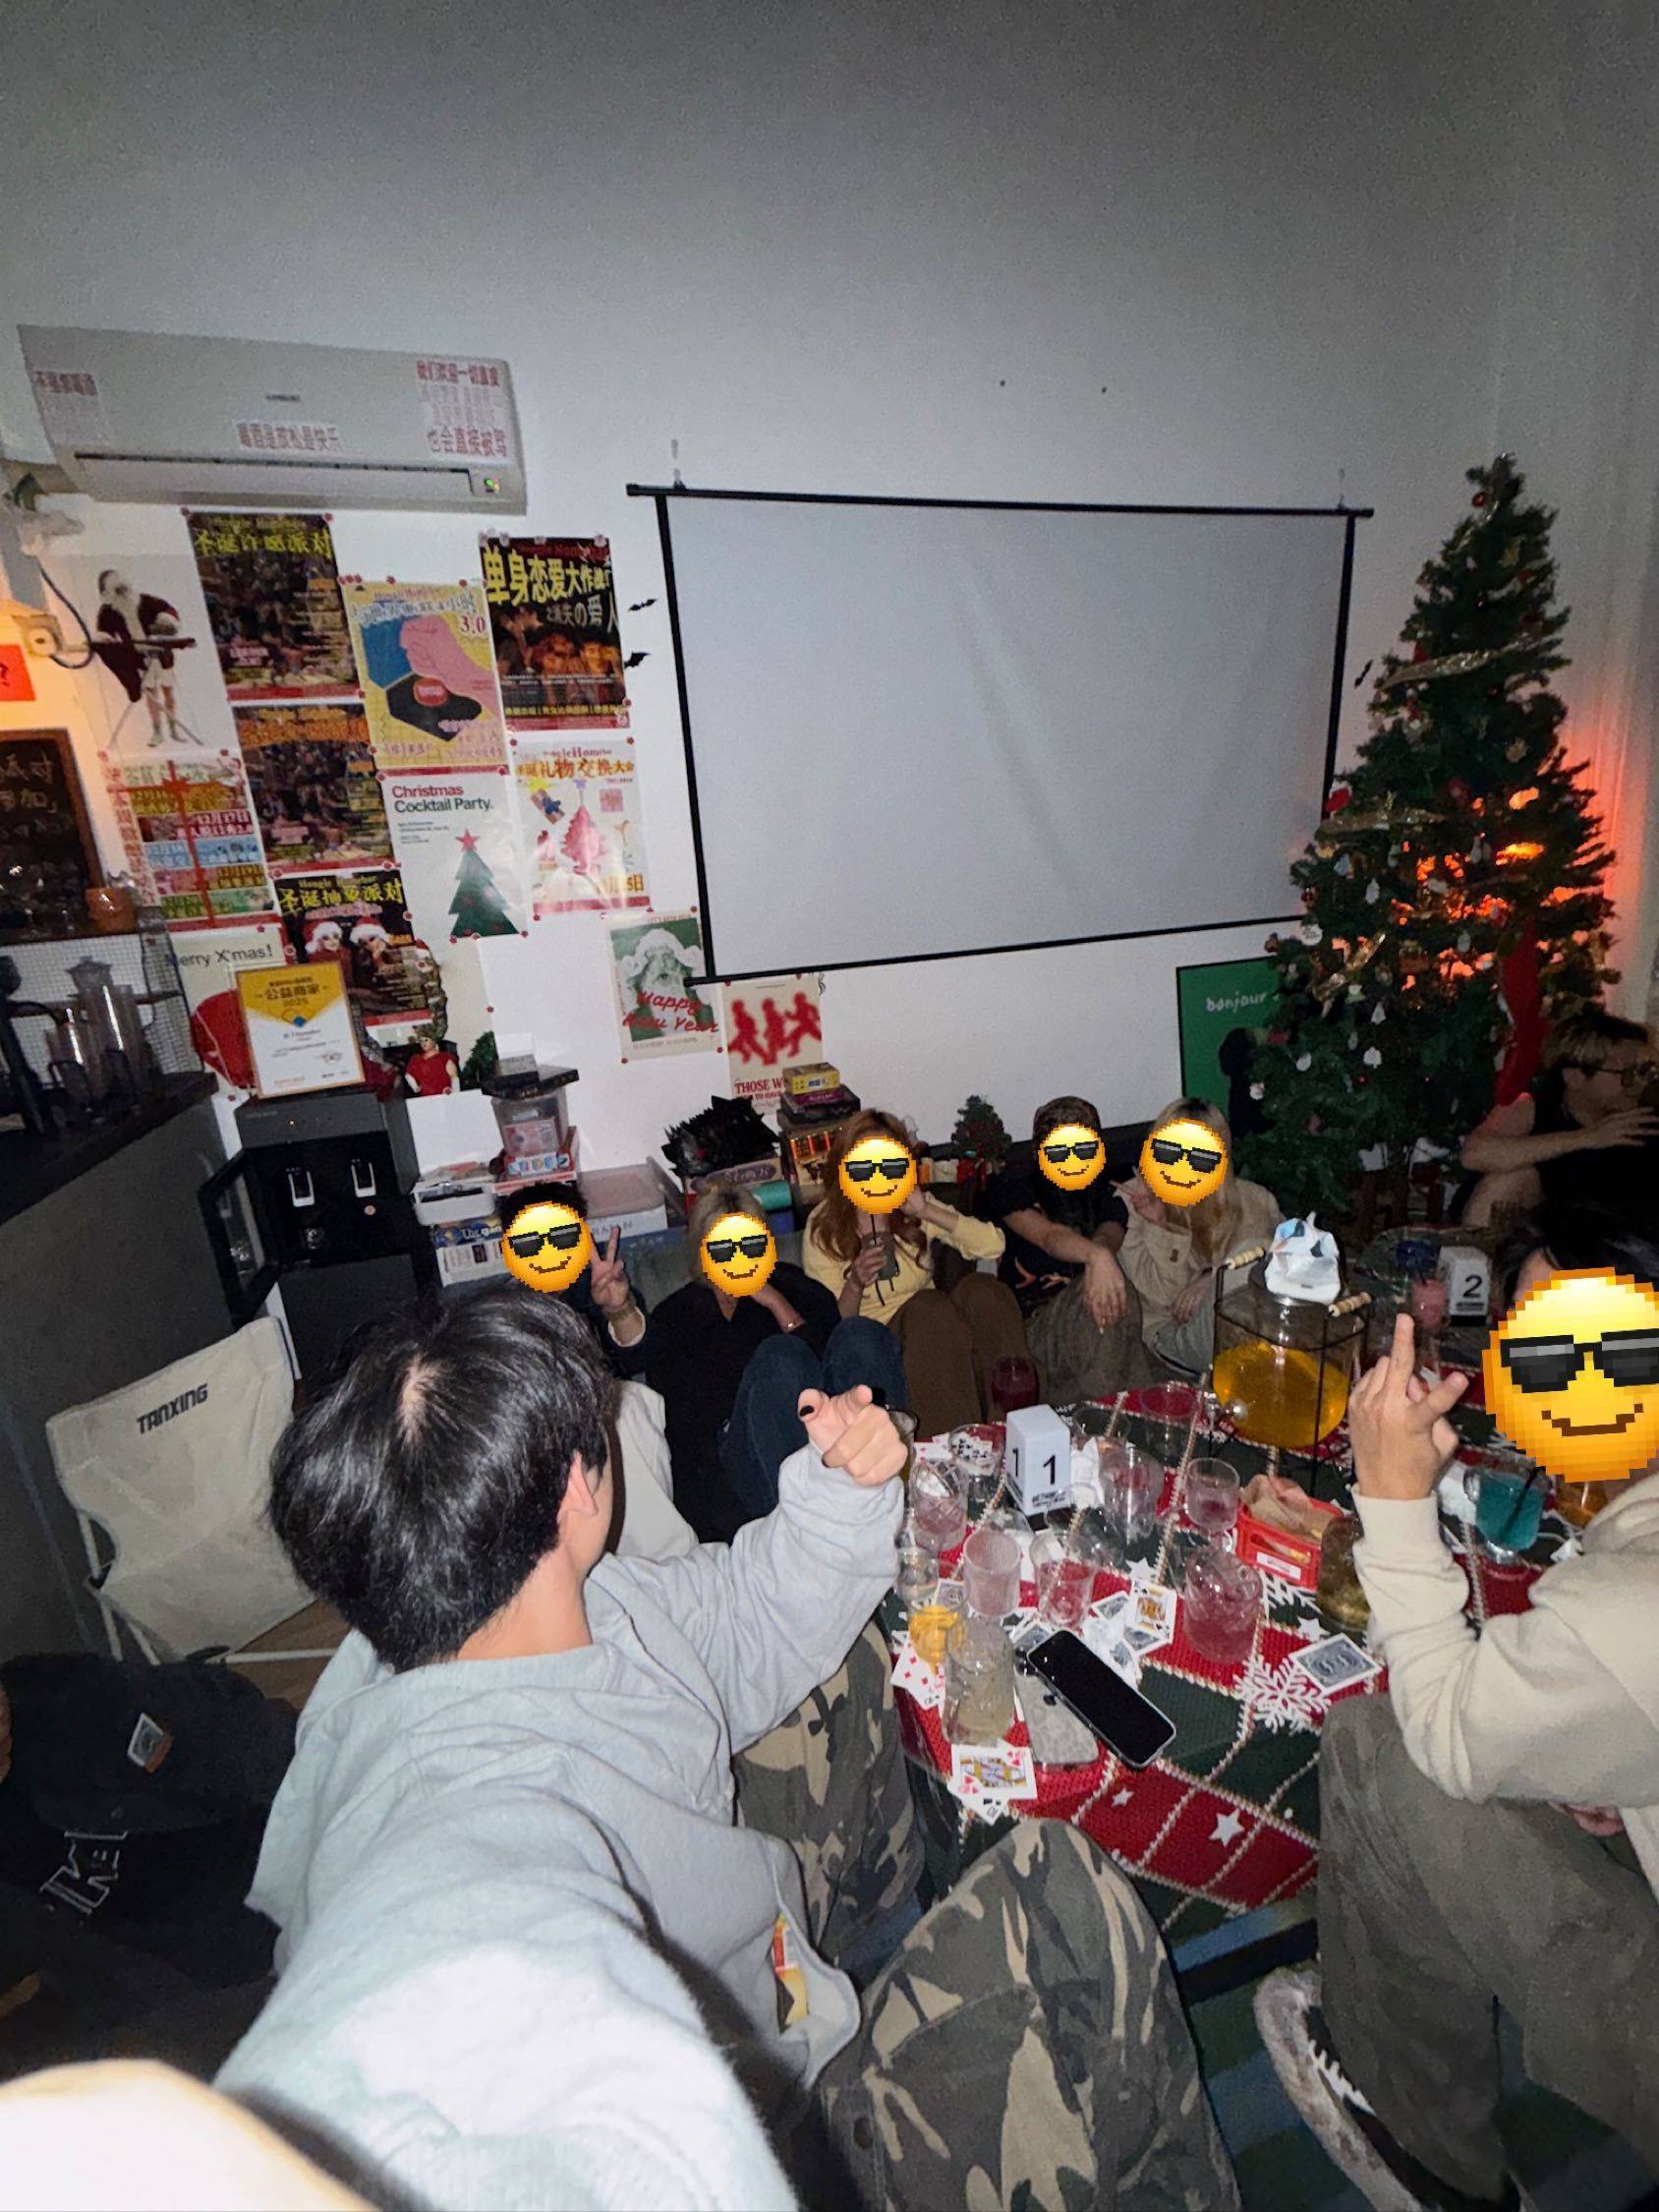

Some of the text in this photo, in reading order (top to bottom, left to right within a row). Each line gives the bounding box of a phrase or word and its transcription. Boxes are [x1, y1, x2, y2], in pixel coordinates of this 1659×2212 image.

[460, 614, 486, 634] 3.0
[392, 785, 465, 799] Christmas
[394, 798, 452, 813] Cocktail
[177, 954, 210, 967] erry
[1206, 991, 1267, 1014] bonjour
[733, 1078, 771, 1094] THOSE
[1462, 1274, 1483, 1298] 2
[1012, 1447, 1019, 1478] 1
[1042, 1454, 1057, 1485] 1
